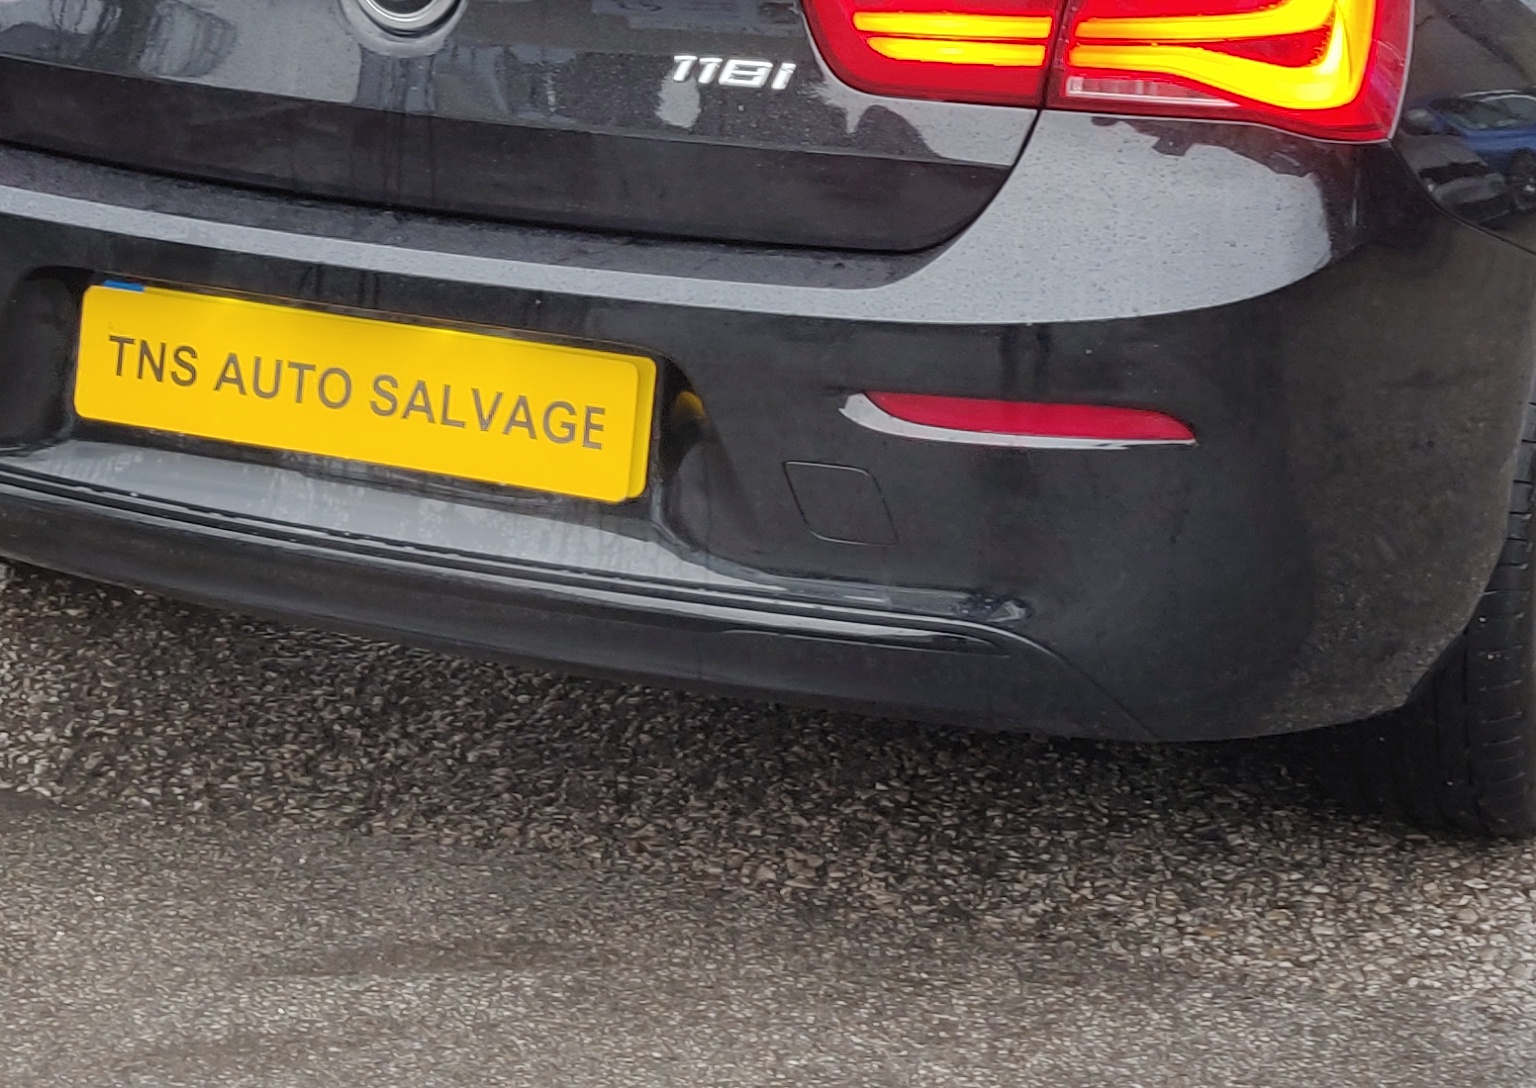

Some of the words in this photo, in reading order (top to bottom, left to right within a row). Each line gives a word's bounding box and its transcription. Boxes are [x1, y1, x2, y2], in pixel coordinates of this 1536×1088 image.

[108, 334, 197, 387] TNS
[213, 352, 352, 409] AUTO
[369, 374, 606, 450] SALVAGE
